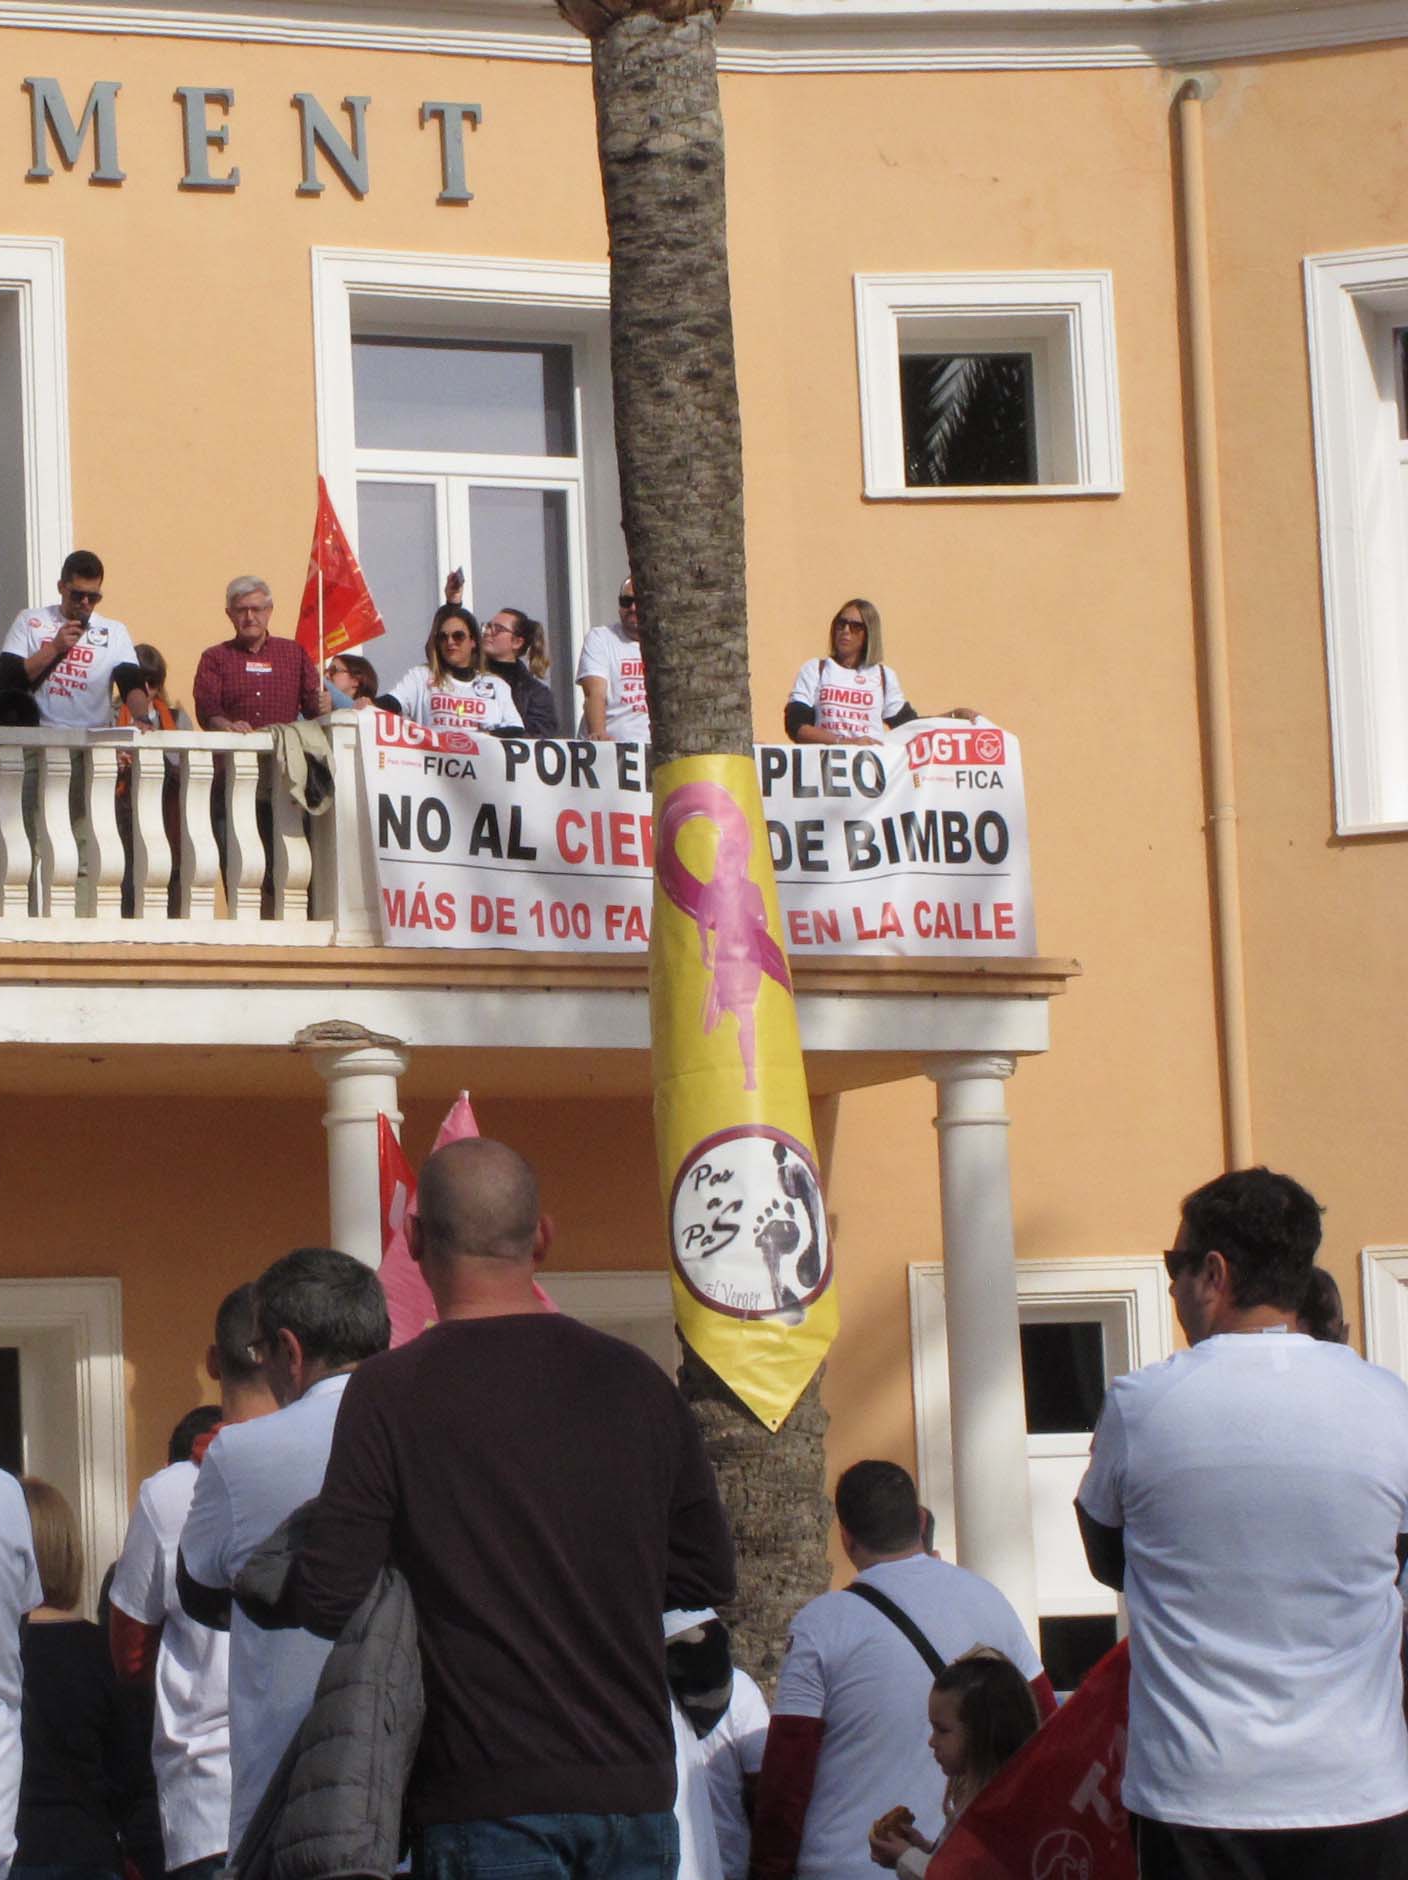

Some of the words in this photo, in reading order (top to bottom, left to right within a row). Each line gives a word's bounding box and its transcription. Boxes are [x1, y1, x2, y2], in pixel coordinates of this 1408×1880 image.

[431, 697, 486, 715] BIMBO
[820, 688, 873, 706] BIMBO
[910, 732, 972, 765] UGT
[424, 755, 477, 780] FICA
[500, 739, 600, 789] POR
[955, 770, 1004, 789] FICA
[378, 793, 451, 853] NO
[469, 803, 537, 861] AL
[844, 809, 1010, 872] BIMBO
[382, 881, 456, 932] MÁS
[470, 895, 517, 935] DE
[529, 900, 592, 940] 100
[604, 904, 653, 942] FA
[787, 909, 841, 945] EN
[852, 902, 904, 940] LA
[913, 900, 1016, 940] CALLE
[689, 1164, 735, 1192] Pas
